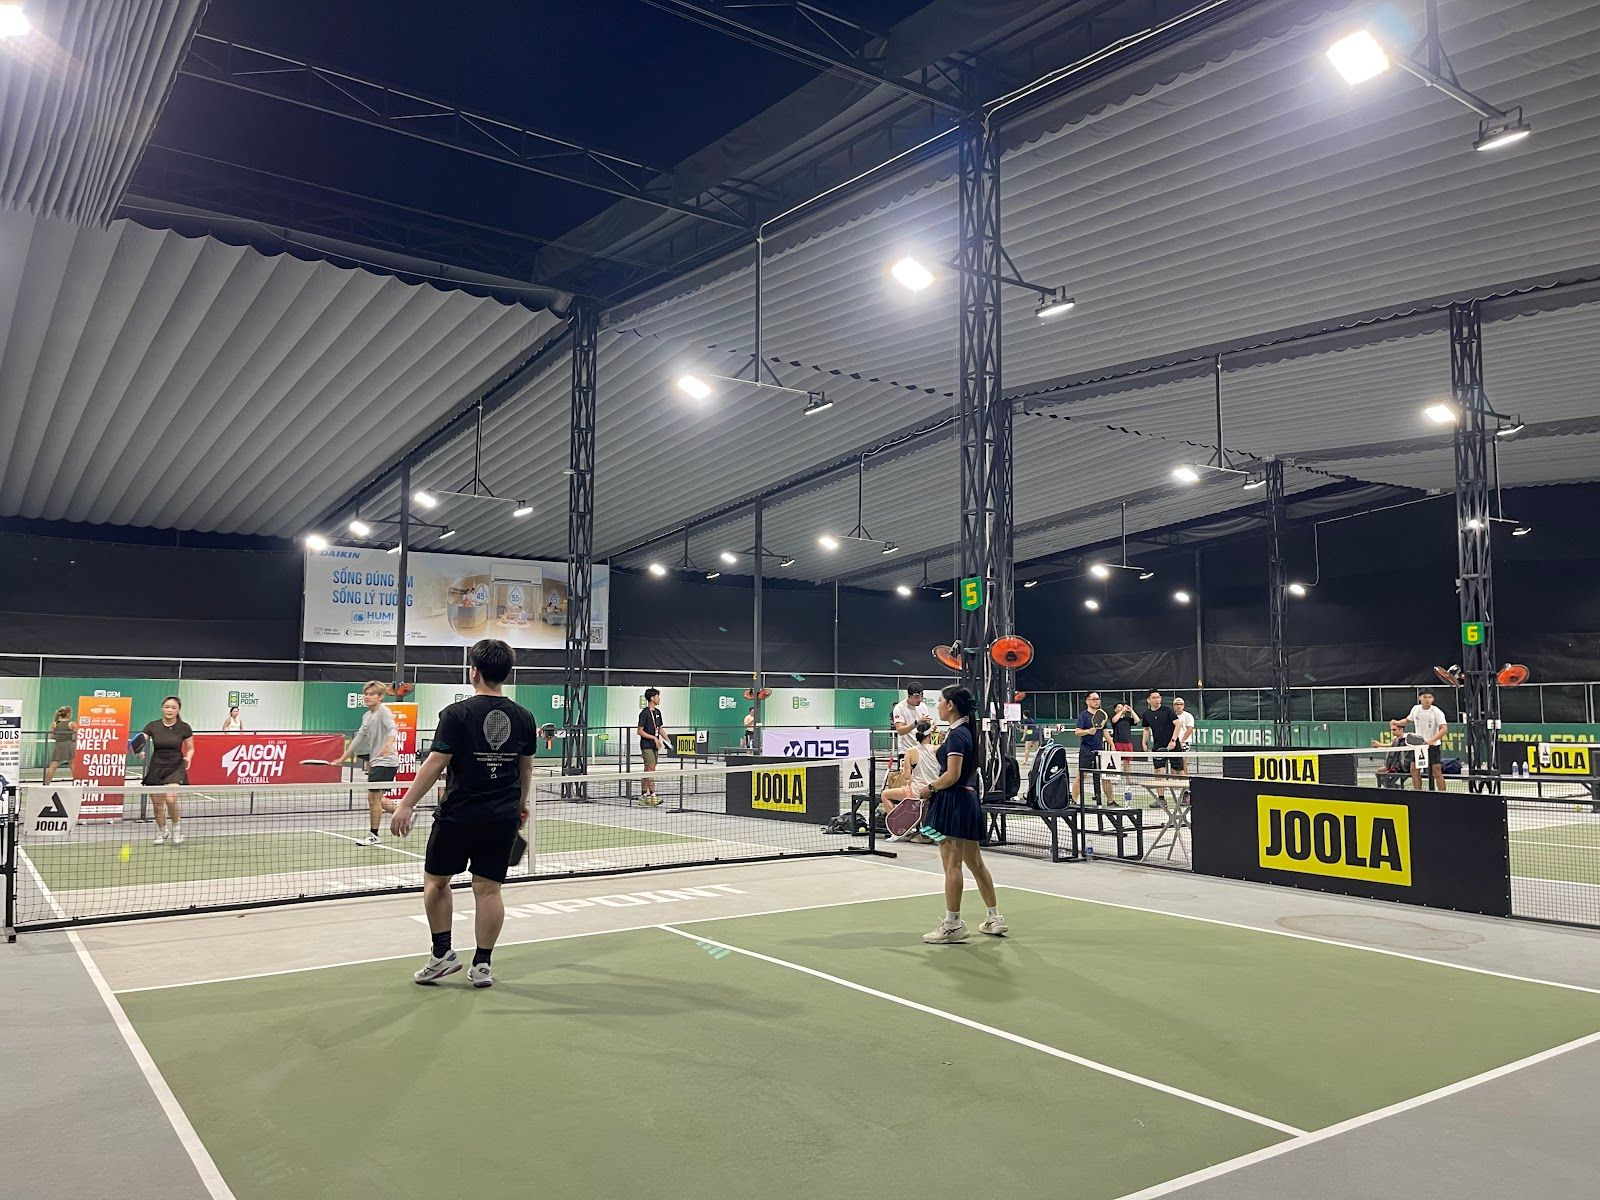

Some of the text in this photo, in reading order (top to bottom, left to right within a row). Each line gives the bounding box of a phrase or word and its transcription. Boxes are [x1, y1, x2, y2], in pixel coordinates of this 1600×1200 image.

[320, 550, 361, 559] DAIKIN
[333, 566, 362, 585] SỐNG
[365, 570, 395, 587] ĐÚNG
[332, 586, 413, 607] SỐNG LÝ TƯỞG
[477, 591, 485, 600] 45
[511, 594, 520, 602] 55
[966, 582, 977, 605] 5
[367, 611, 394, 620] HUMI
[1467, 625, 1478, 642] 6
[77, 728, 119, 740] SOCIAL
[1212, 728, 1224, 745] IS
[1228, 729, 1272, 746] YOURS
[76, 739, 109, 751] MEET
[83, 753, 126, 766] SAIGON
[1532, 751, 1586, 769] JOLA
[88, 765, 126, 777] SOUTH
[1258, 758, 1315, 782] JOOLA
[237, 776, 270, 784] PICKLEBALL
[848, 780, 864, 789] JOOLA
[754, 772, 803, 805] JOOLA
[34, 821, 68, 831] JOOLA
[1265, 808, 1403, 872] JOOLA
